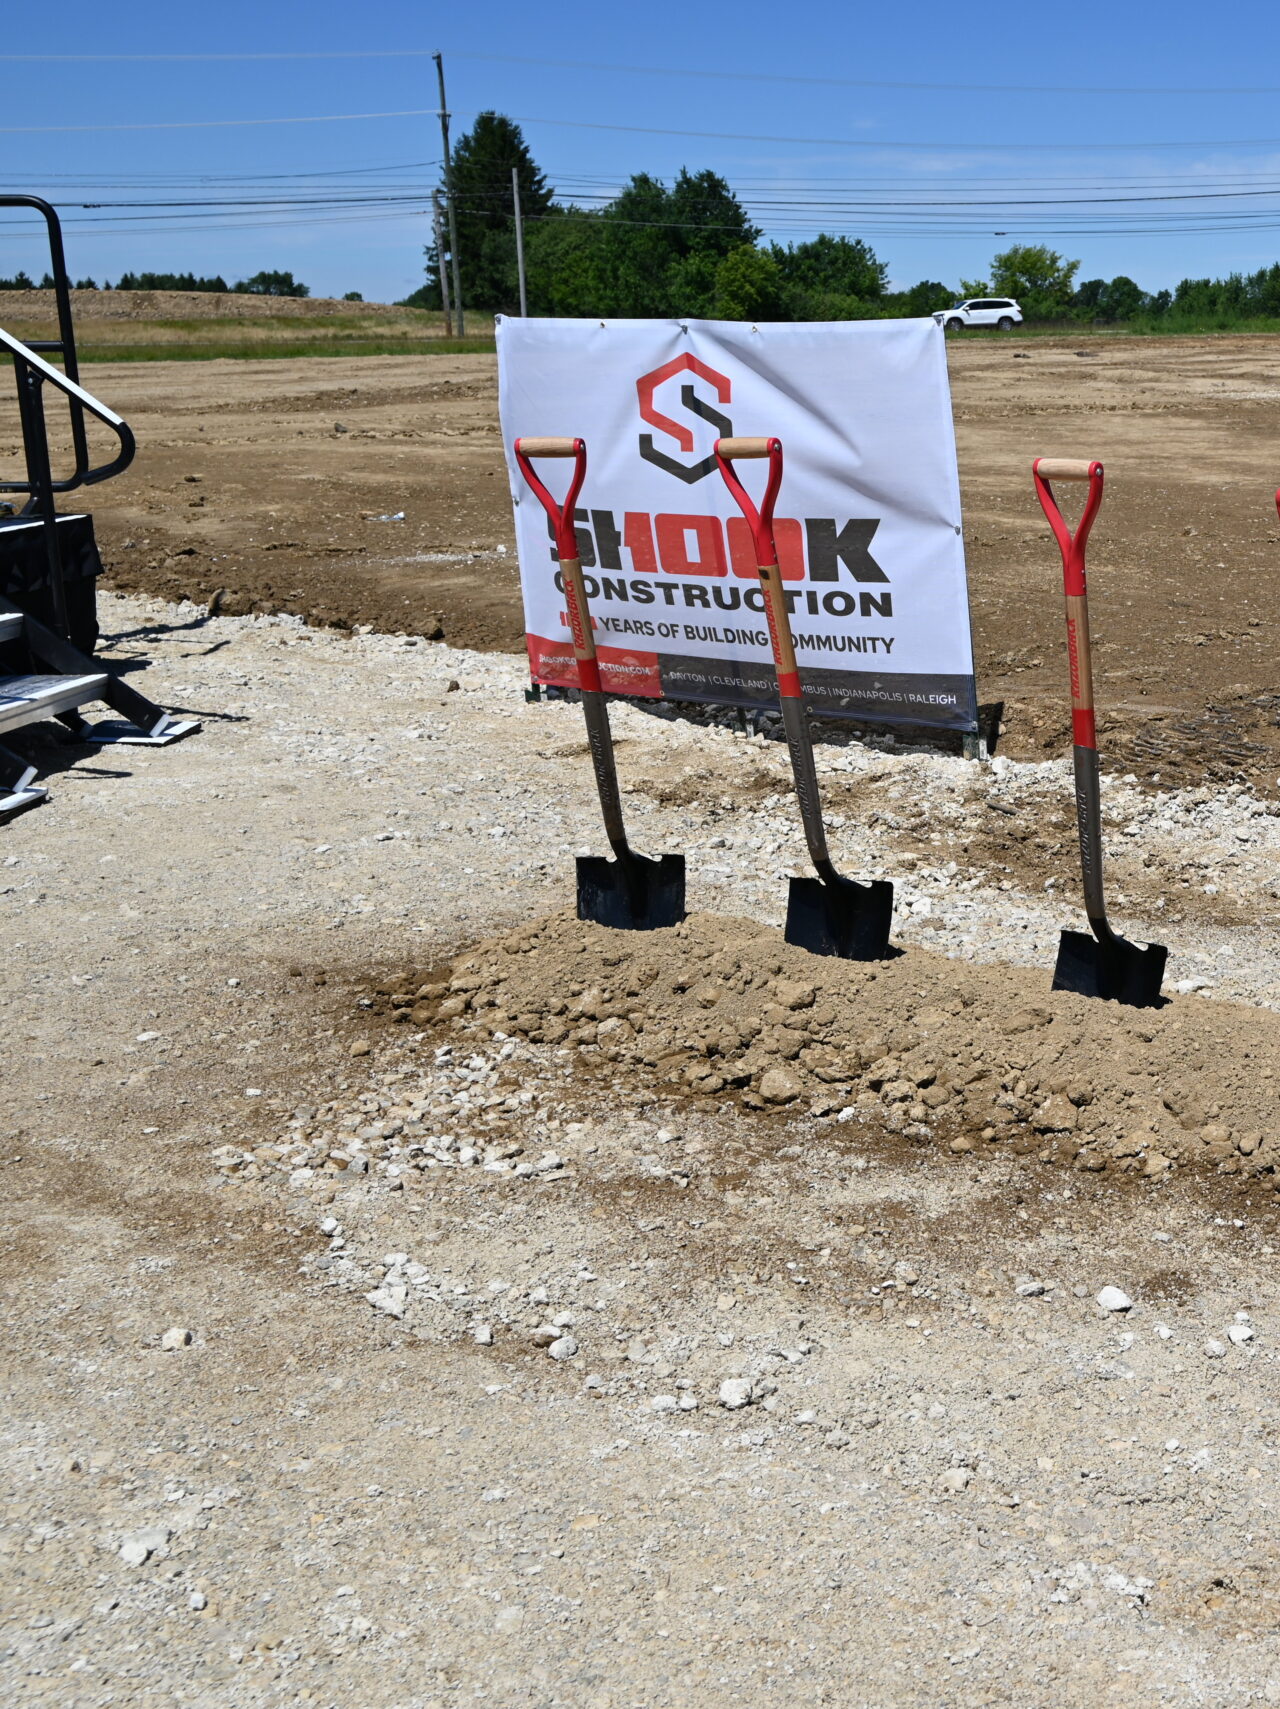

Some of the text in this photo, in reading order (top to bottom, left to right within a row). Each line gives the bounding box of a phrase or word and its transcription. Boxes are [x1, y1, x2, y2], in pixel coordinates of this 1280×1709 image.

[547, 504, 890, 583] SHOOK
[598, 616, 656, 637] YEARS
[657, 622, 680, 639] OF
[683, 624, 769, 647] BUILDING
[791, 633, 895, 654] OMMUNITY
[669, 671, 957, 705] DAYTON CLEVELAND CMBUS INDIANAPOLIS RALEIGH
